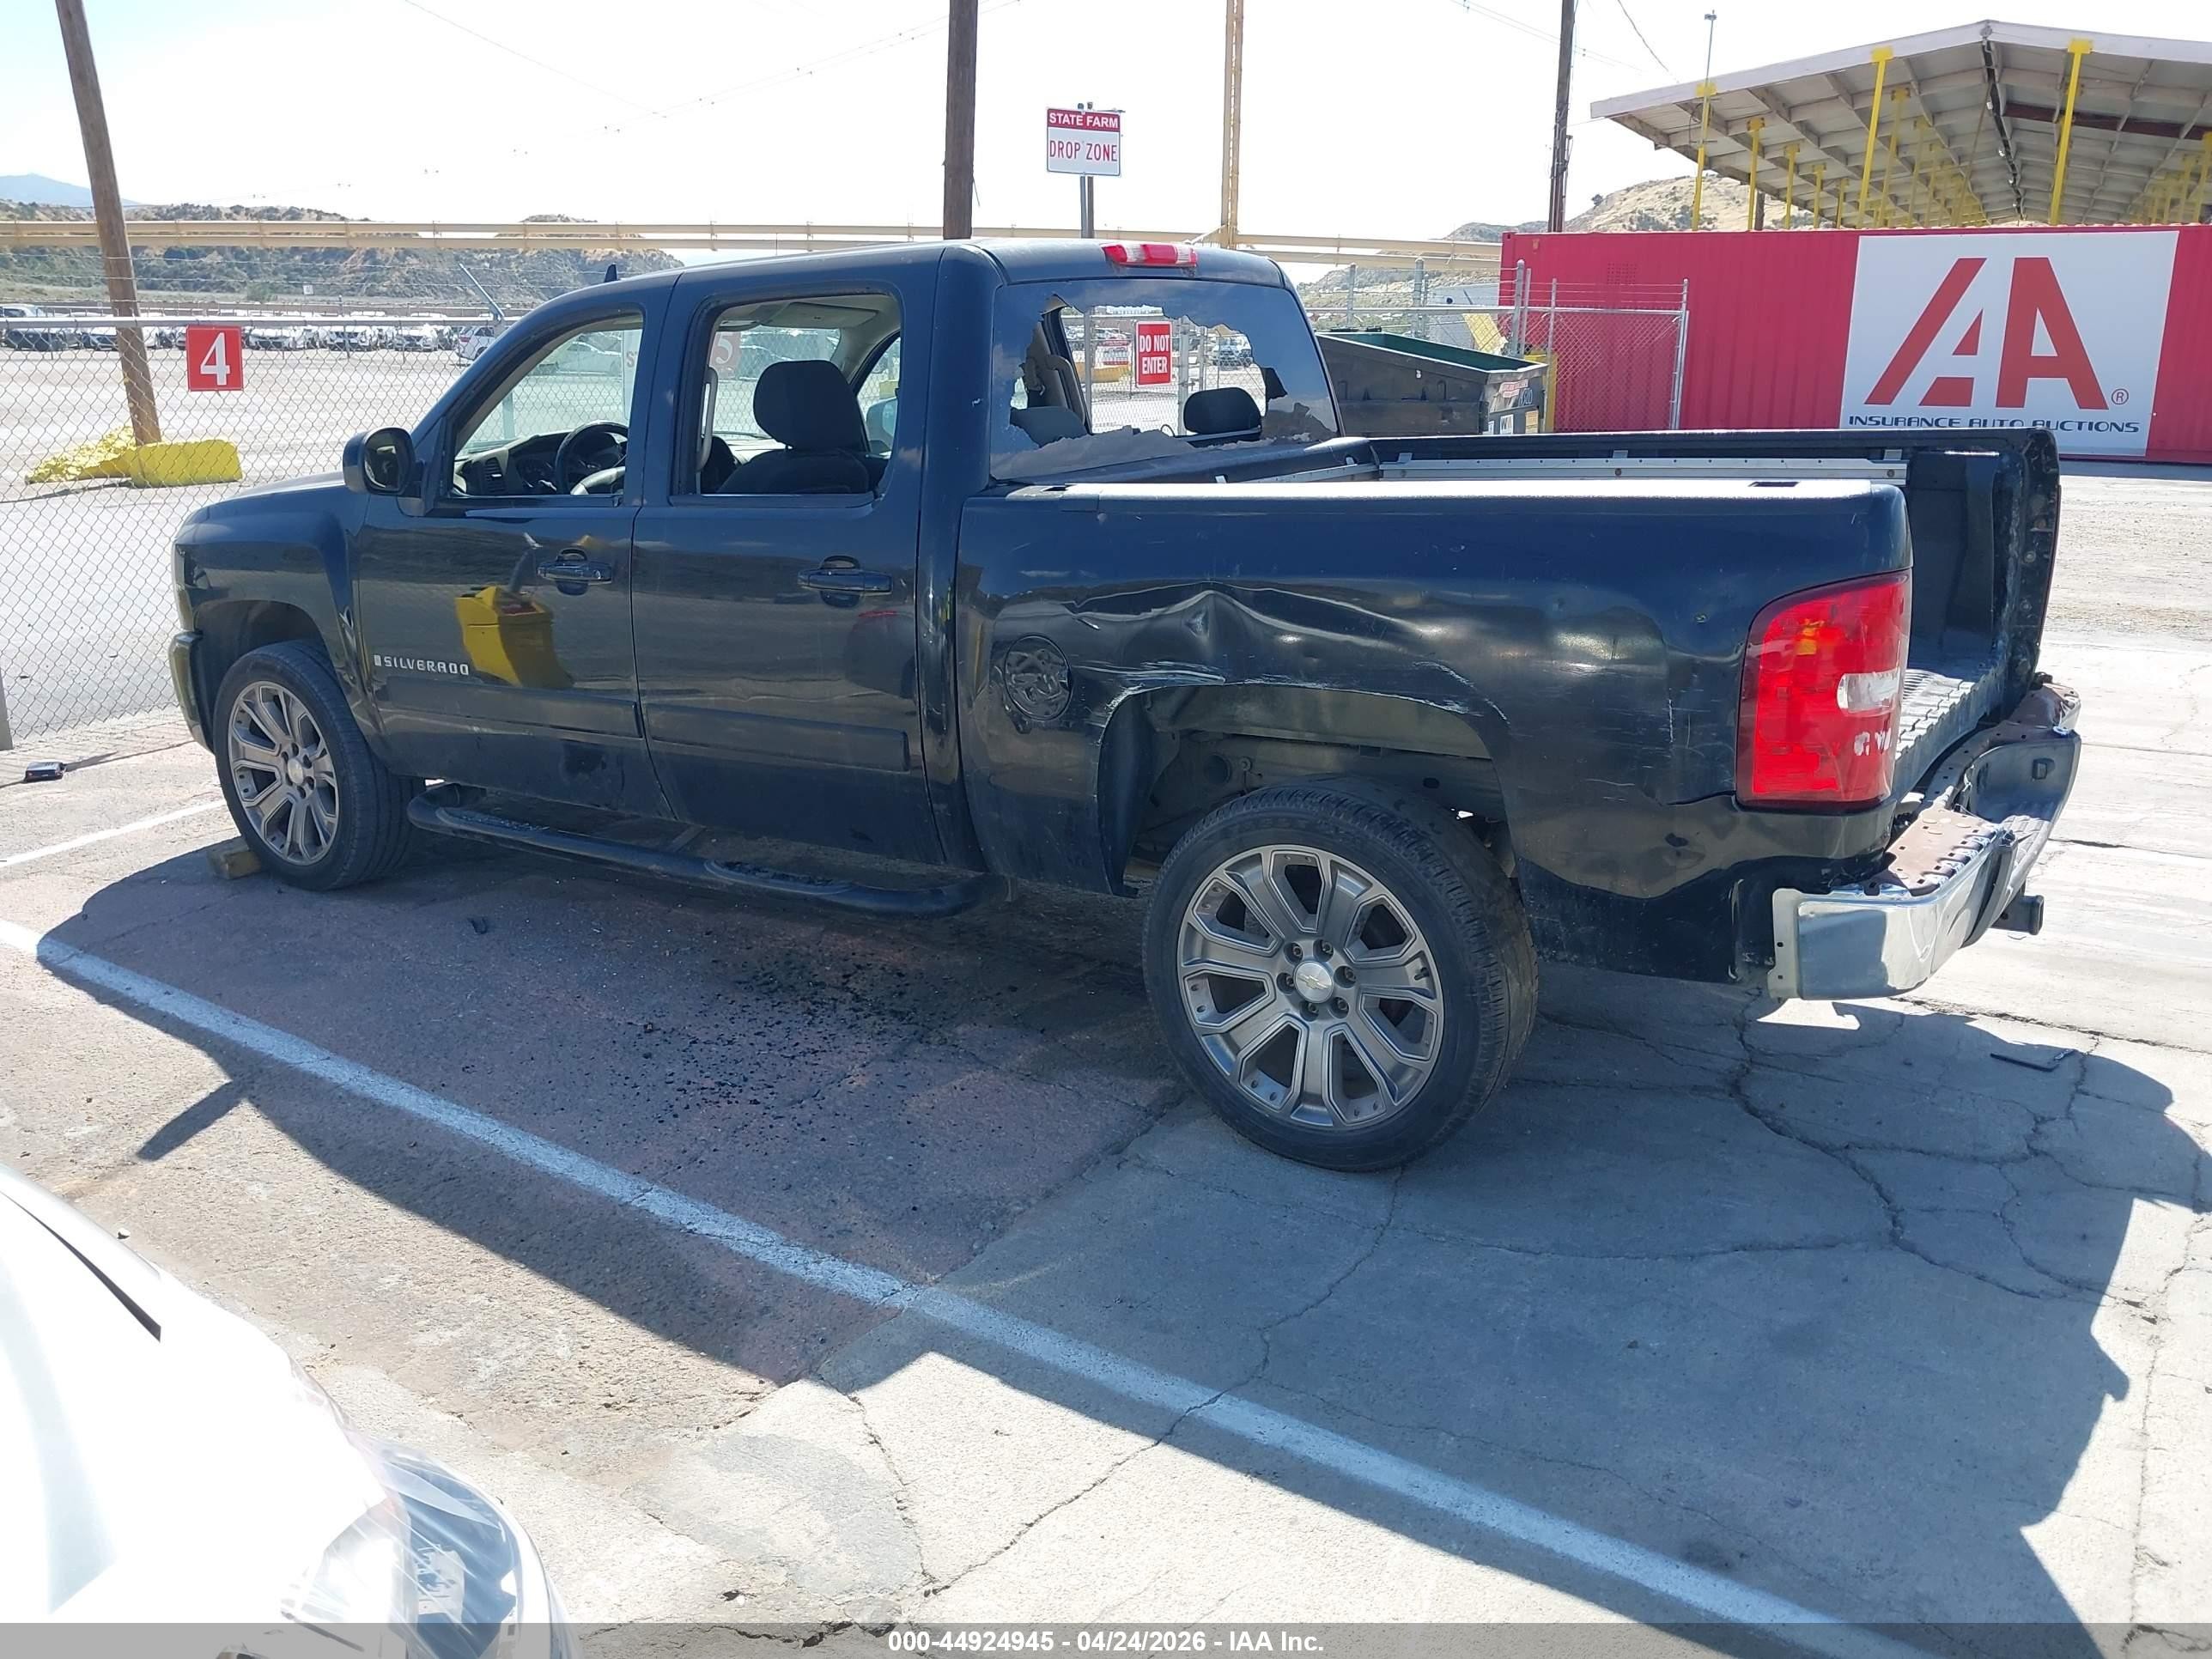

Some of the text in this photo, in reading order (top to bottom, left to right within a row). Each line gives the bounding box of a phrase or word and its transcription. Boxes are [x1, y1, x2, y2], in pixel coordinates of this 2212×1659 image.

[1049, 112, 1118, 128] STATE FARM
[1049, 140, 1118, 161] DROP ZONE
[1139, 335, 1152, 353] DO
[1153, 334, 1170, 352] NOT
[200, 331, 231, 386] 4
[1141, 356, 1168, 374] ENTER
[1849, 416, 2141, 433] INSURANCE AUTO AUCTIONS
[384, 656, 469, 676] SILVERADO
